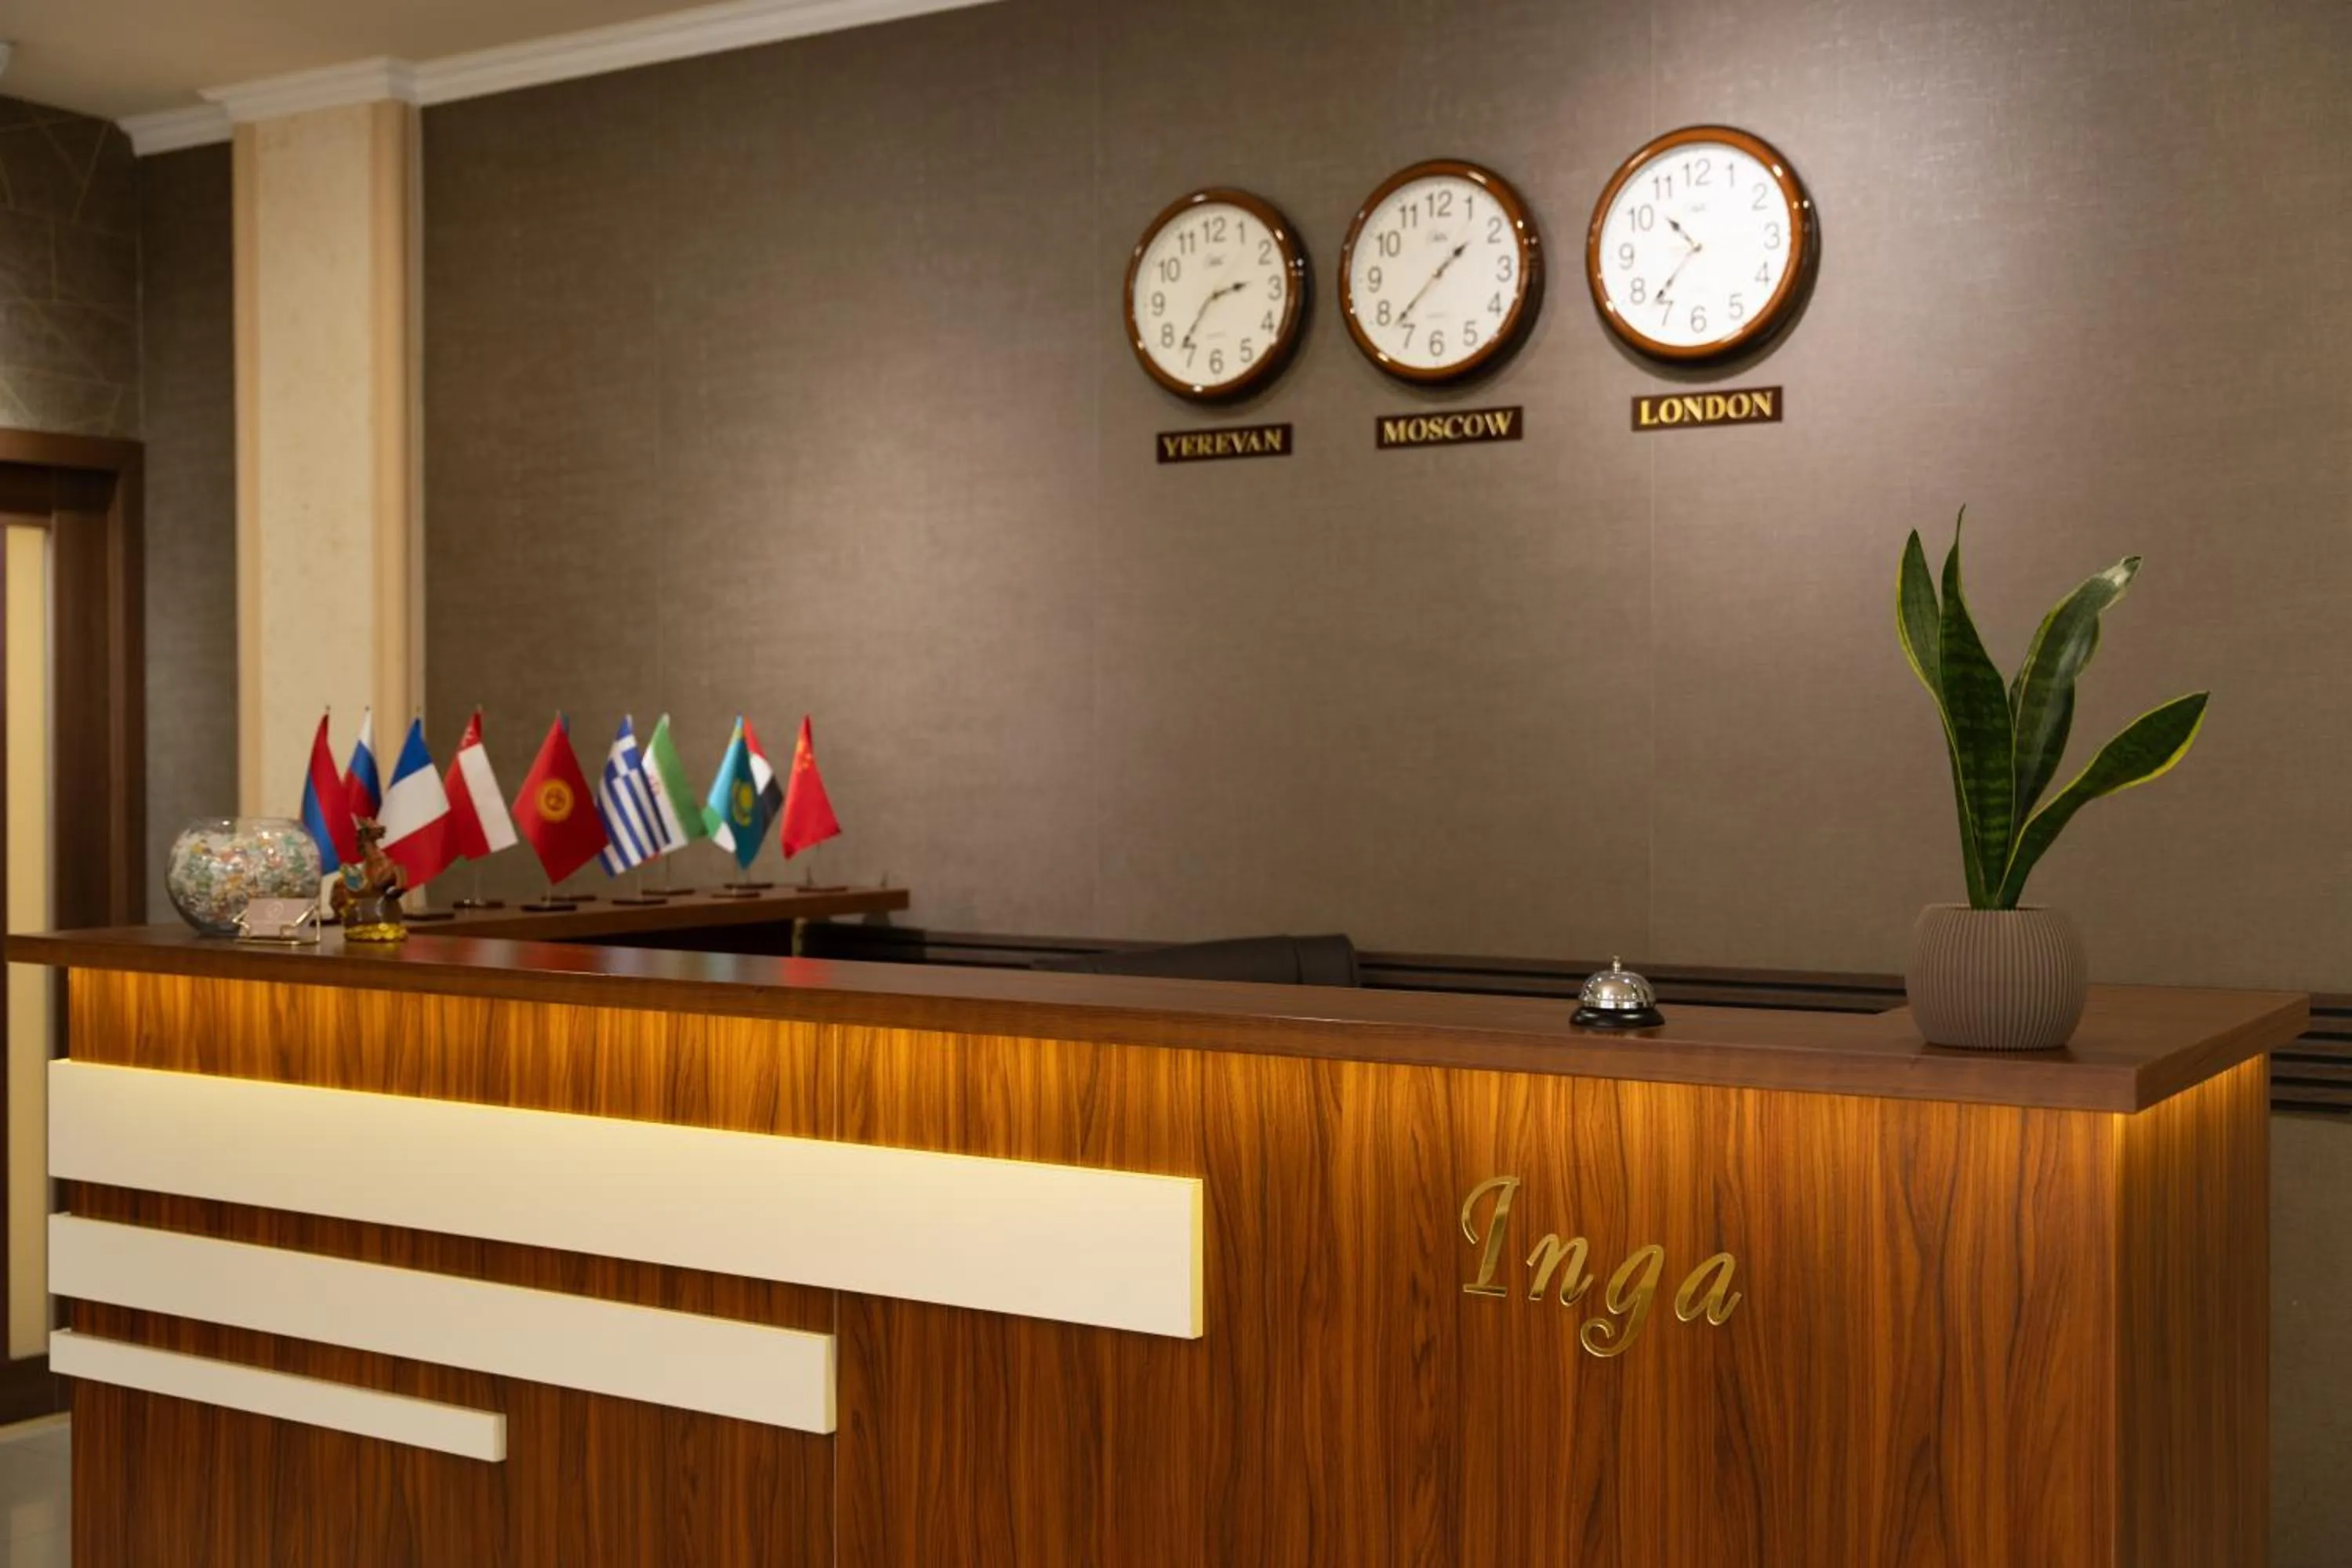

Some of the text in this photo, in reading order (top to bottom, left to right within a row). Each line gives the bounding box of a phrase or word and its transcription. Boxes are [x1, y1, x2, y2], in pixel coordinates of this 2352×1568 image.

[1682, 158, 1711, 187] 12
[1728, 162, 1734, 187] 1
[1653, 176, 1671, 200] 11
[1751, 183, 1767, 210] 2
[1399, 204, 1417, 229] 11
[1426, 191, 1452, 218] 12
[1465, 194, 1473, 220] 1
[1203, 216, 1225, 244] 12
[1487, 217, 1502, 244] 2
[1628, 204, 1654, 232] 10
[1178, 230, 1195, 255] 11
[1238, 221, 1246, 244] 1
[1376, 230, 1401, 257] 10
[1764, 223, 1780, 249] 3
[1258, 239, 1272, 266] 2
[1618, 243, 1634, 270] 9
[1159, 257, 1181, 283] 10
[1367, 267, 1381, 292] 9
[1496, 256, 1512, 282] 3
[1755, 262, 1770, 285] 4
[1269, 275, 1282, 300] 3
[1631, 278, 1646, 304] 8
[1152, 292, 1165, 317] 9
[1377, 300, 1390, 326] 8
[1488, 292, 1502, 317] 4
[1657, 299, 1673, 326] 7
[1729, 293, 1744, 320] 5
[1261, 310, 1274, 333] 4
[1690, 306, 1706, 332] 6
[1161, 323, 1174, 348] 8
[1402, 324, 1416, 349] 7
[1429, 330, 1443, 357] 6
[1463, 320, 1478, 347] 5
[1182, 342, 1196, 368] 7
[1210, 350, 1223, 374] 6
[1240, 338, 1254, 363] 5
[1640, 390, 1773, 425] LONDON
[1383, 411, 1513, 444] MOSCOW
[1161, 429, 1282, 458] YEREVAN
[1461, 1176, 1742, 1357] Inga
